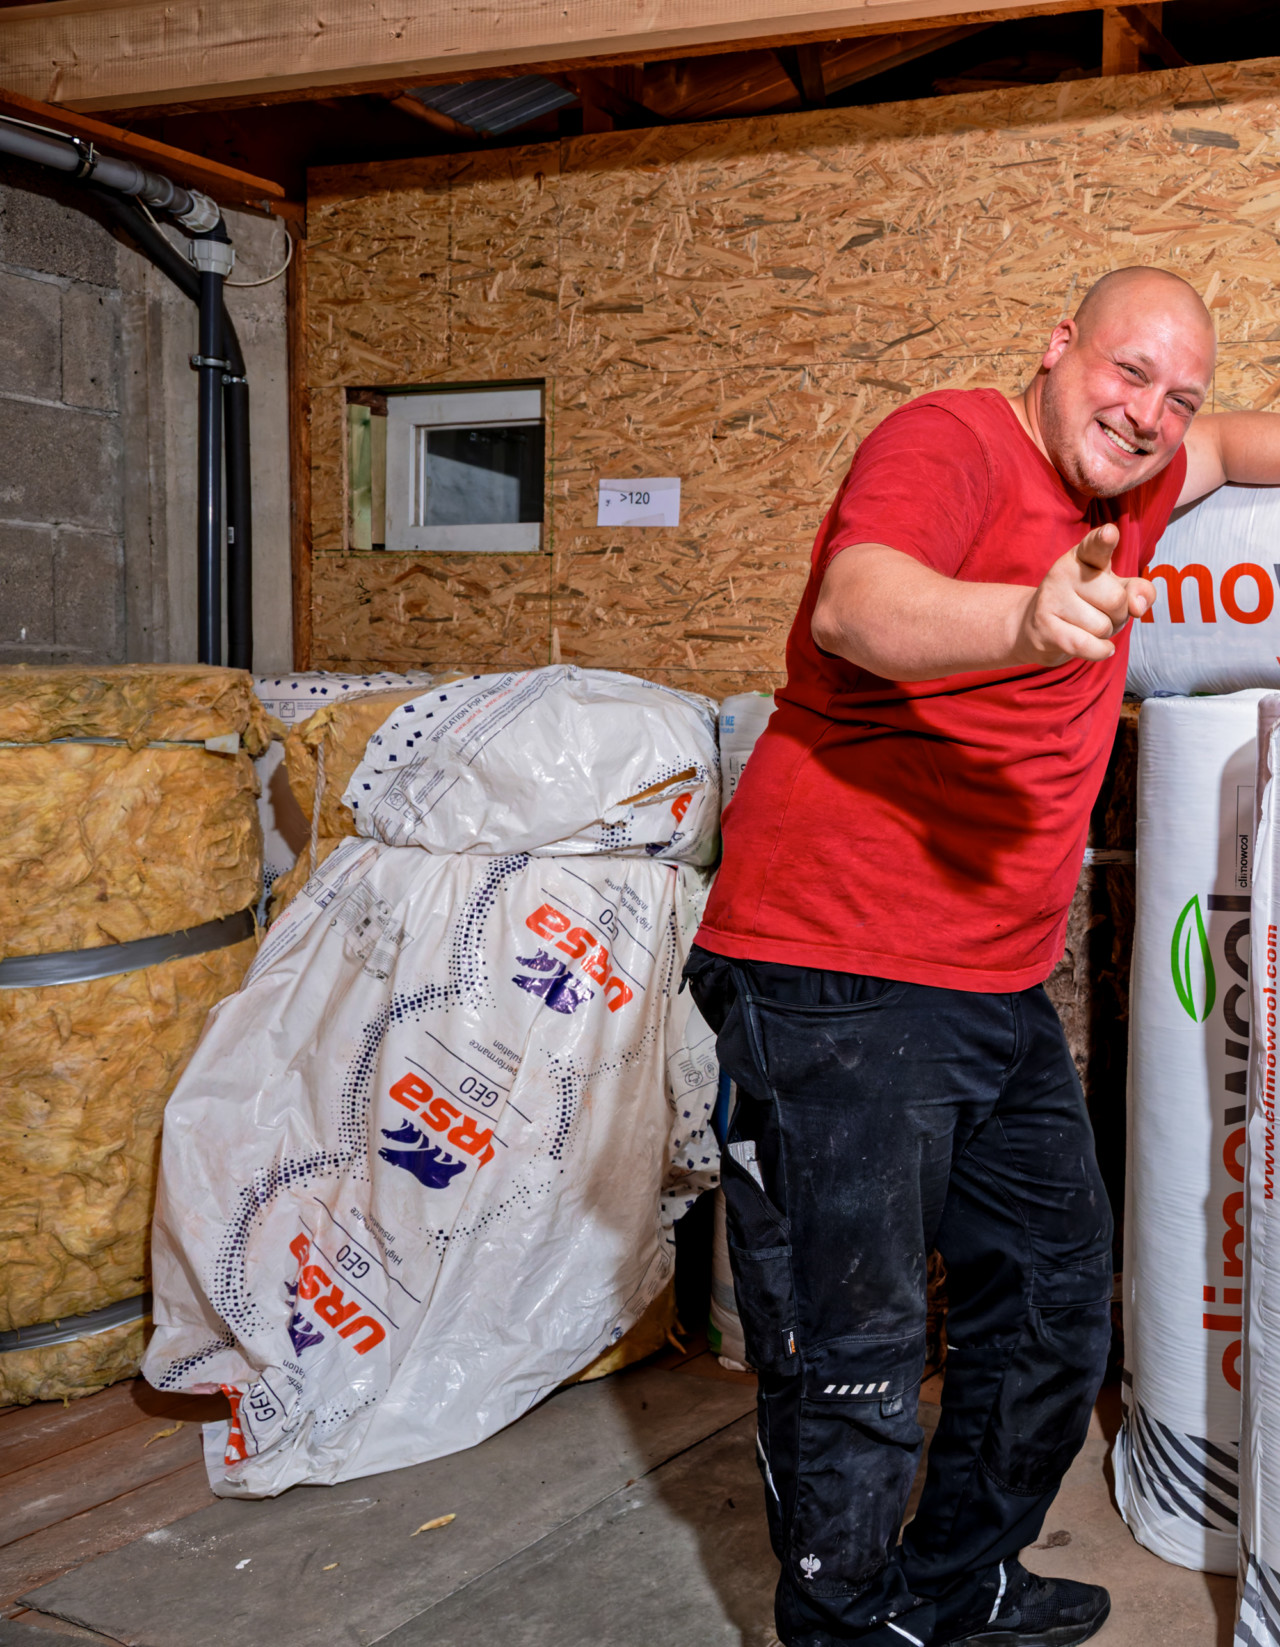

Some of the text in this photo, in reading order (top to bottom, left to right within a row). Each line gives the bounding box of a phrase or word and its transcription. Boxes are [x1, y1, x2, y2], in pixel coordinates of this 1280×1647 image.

[619, 491, 651, 505] >120
[432, 707, 469, 743] INSULATION
[468, 696, 482, 710] FOR
[1238, 835, 1248, 888] climowool
[491, 1040, 523, 1065] sulation
[1262, 924, 1278, 1200] www.climowool.com
[457, 1076, 499, 1109] GEO
[336, 1244, 371, 1279] GEO
[384, 1247, 403, 1266] High
